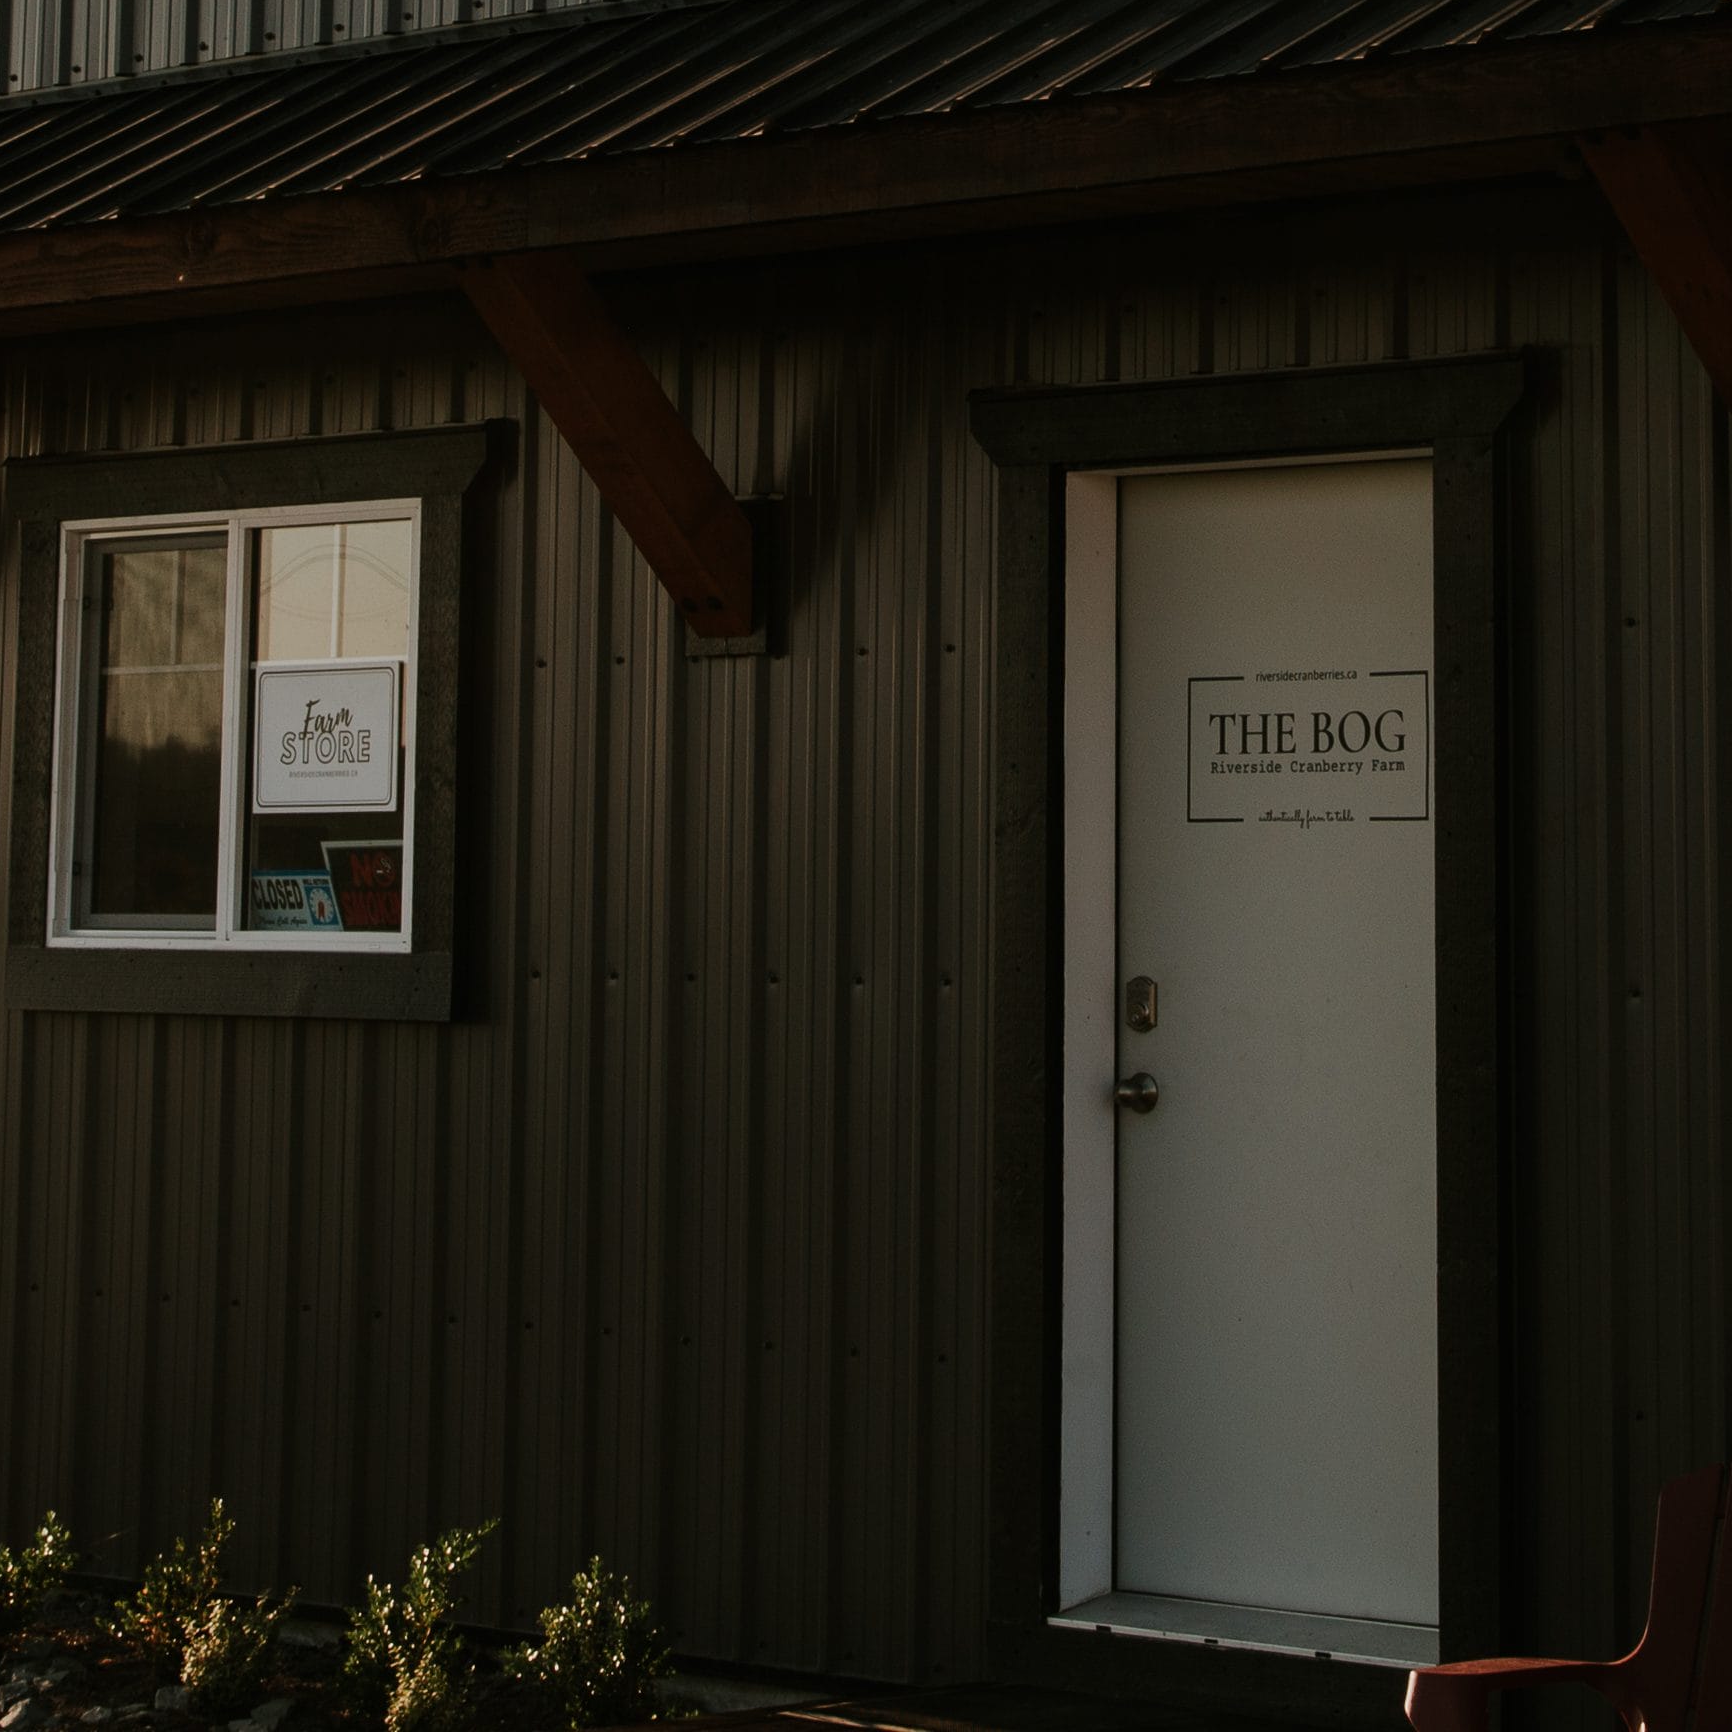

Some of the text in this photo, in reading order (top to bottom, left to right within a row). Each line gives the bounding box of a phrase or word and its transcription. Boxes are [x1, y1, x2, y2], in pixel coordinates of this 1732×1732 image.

[1255, 669, 1358, 683] riversidecranberries.ca
[299, 699, 354, 741] Farm
[1208, 709, 1406, 755] THE BOG
[280, 728, 372, 766] STORE
[1210, 758, 1406, 776] Riverside Cranberry Farm
[349, 852, 397, 888] NO
[252, 878, 304, 910] CLOSED
